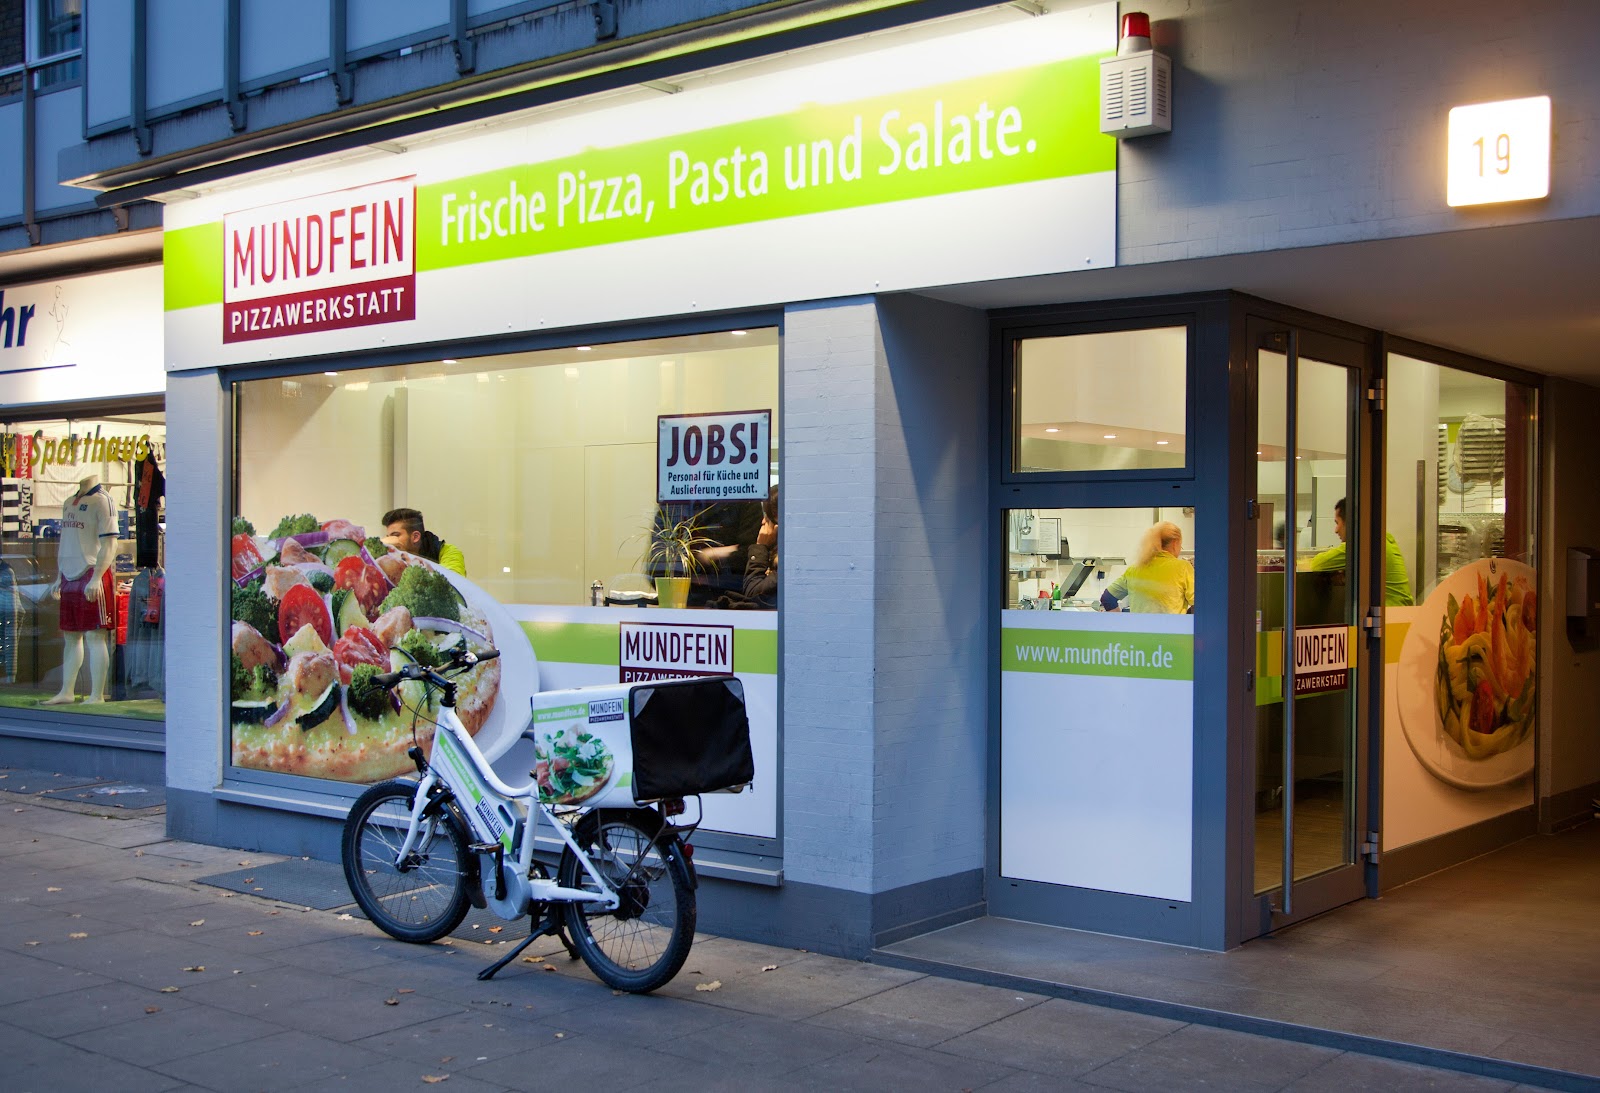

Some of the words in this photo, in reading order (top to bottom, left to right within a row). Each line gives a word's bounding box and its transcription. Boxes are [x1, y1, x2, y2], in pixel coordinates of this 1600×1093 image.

[1472, 133, 1511, 177] 19
[441, 181, 547, 247] Frische
[557, 169, 655, 227] Pizza,
[668, 150, 769, 210] Pasta
[784, 115, 863, 191] und
[878, 100, 1037, 176] Salate.
[233, 197, 405, 290] MUNDFEIN
[231, 287, 406, 335] PIZZAWERKSTATT
[29, 424, 151, 475] Sporthaus
[666, 422, 759, 467] JOBS!
[667, 470, 701, 482] Personal
[703, 470, 715, 482] für
[717, 470, 741, 481] Küche
[743, 469, 759, 480] und
[670, 484, 721, 497] Auslieferung
[722, 483, 758, 496] gesucht.
[625, 630, 727, 666] MUNDFEIN
[1015, 643, 1173, 669] www.mundfein.de
[1296, 633, 1345, 668] UNDFEIN
[590, 700, 623, 715] MUNDFEIN
[479, 799, 505, 835] MUNDFEIN
